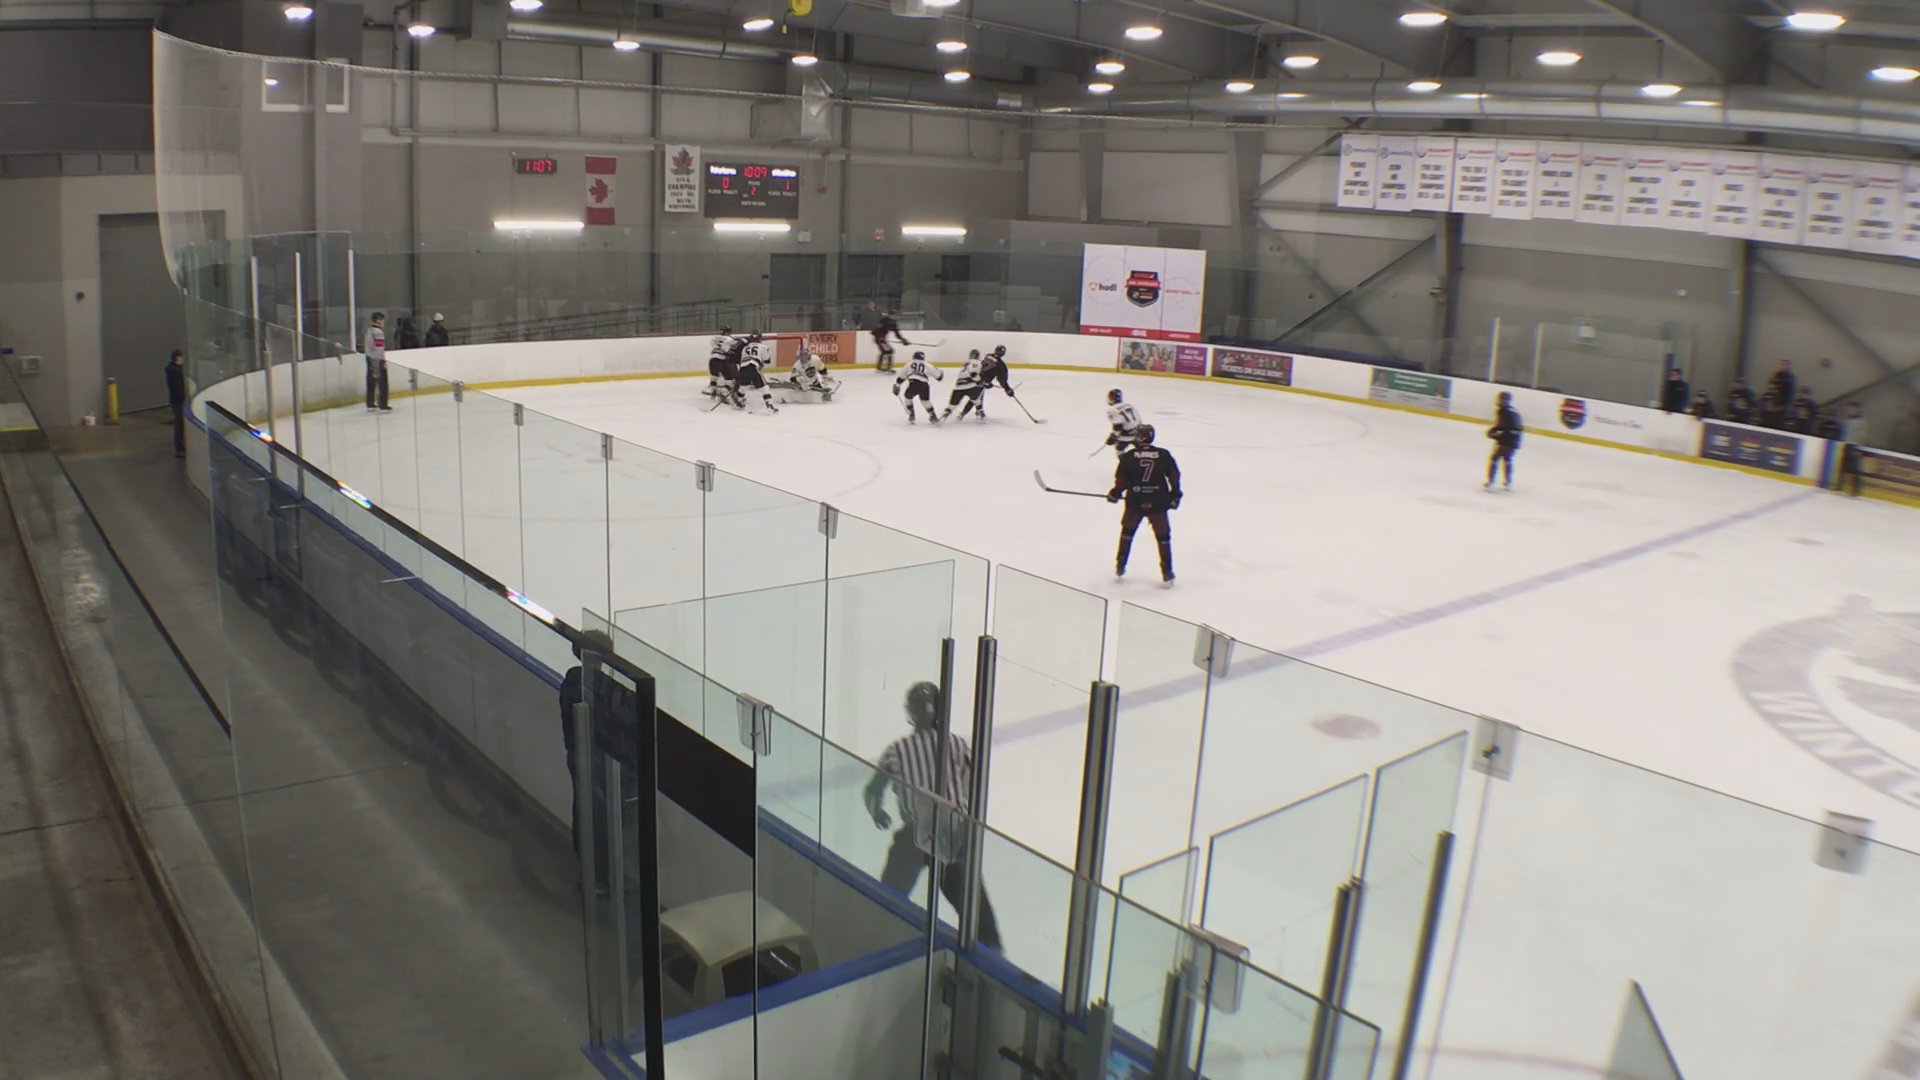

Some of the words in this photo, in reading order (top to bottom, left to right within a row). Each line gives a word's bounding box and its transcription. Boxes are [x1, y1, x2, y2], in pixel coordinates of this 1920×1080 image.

[525, 160, 553, 172] 11:07
[722, 177, 730, 189] 0
[1098, 283, 1117, 291] hudl
[809, 334, 838, 342] EVERY
[809, 344, 838, 353] CHILD
[1119, 408, 1136, 422] 17
[1139, 459, 1156, 482] 7
